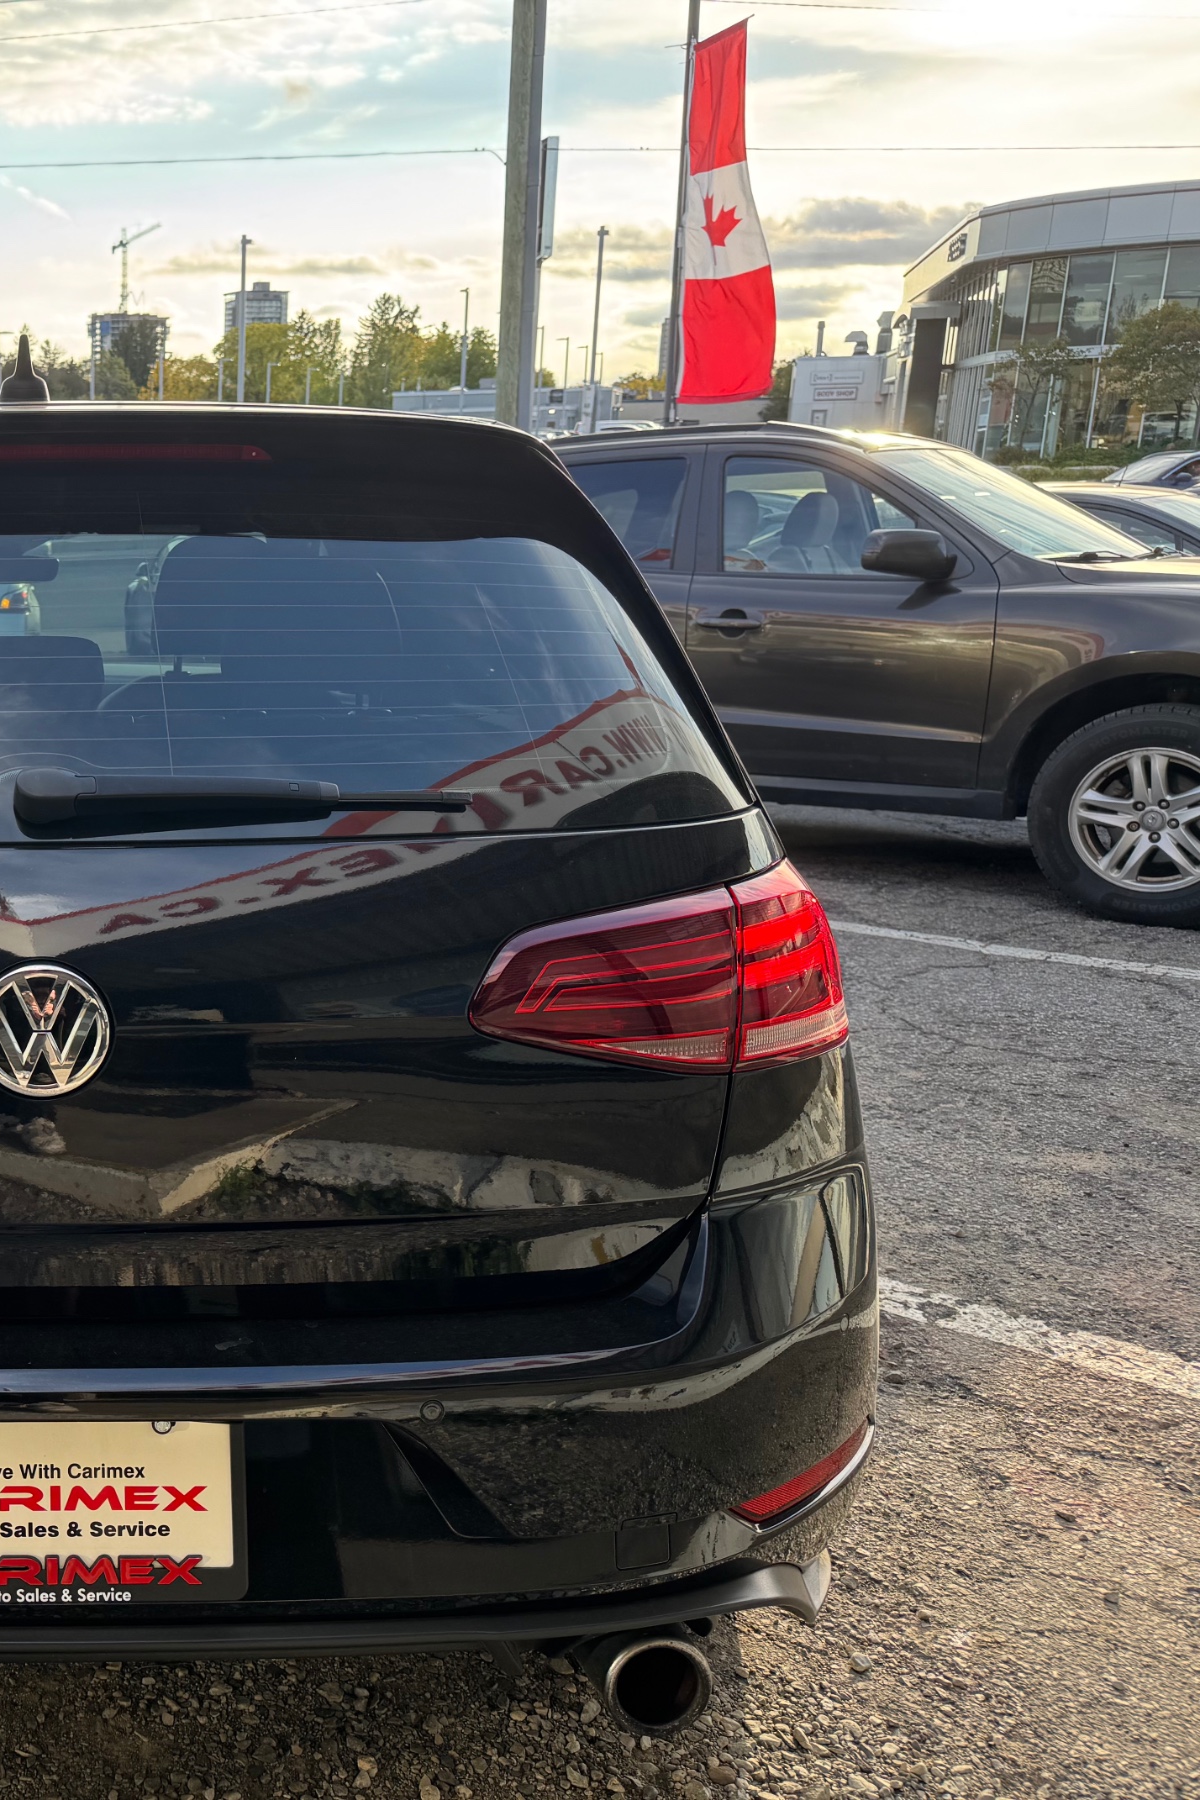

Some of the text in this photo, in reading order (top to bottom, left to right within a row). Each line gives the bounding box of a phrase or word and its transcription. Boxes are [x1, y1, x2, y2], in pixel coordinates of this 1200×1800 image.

[19, 1463, 62, 1479] With
[67, 1463, 146, 1479] Carimex
[0, 1522, 60, 1538] Sales
[66, 1521, 83, 1537] &
[89, 1521, 171, 1537] Service
[16, 1588, 57, 1603] Sales
[61, 1588, 72, 1603] &
[77, 1587, 132, 1602] Service
